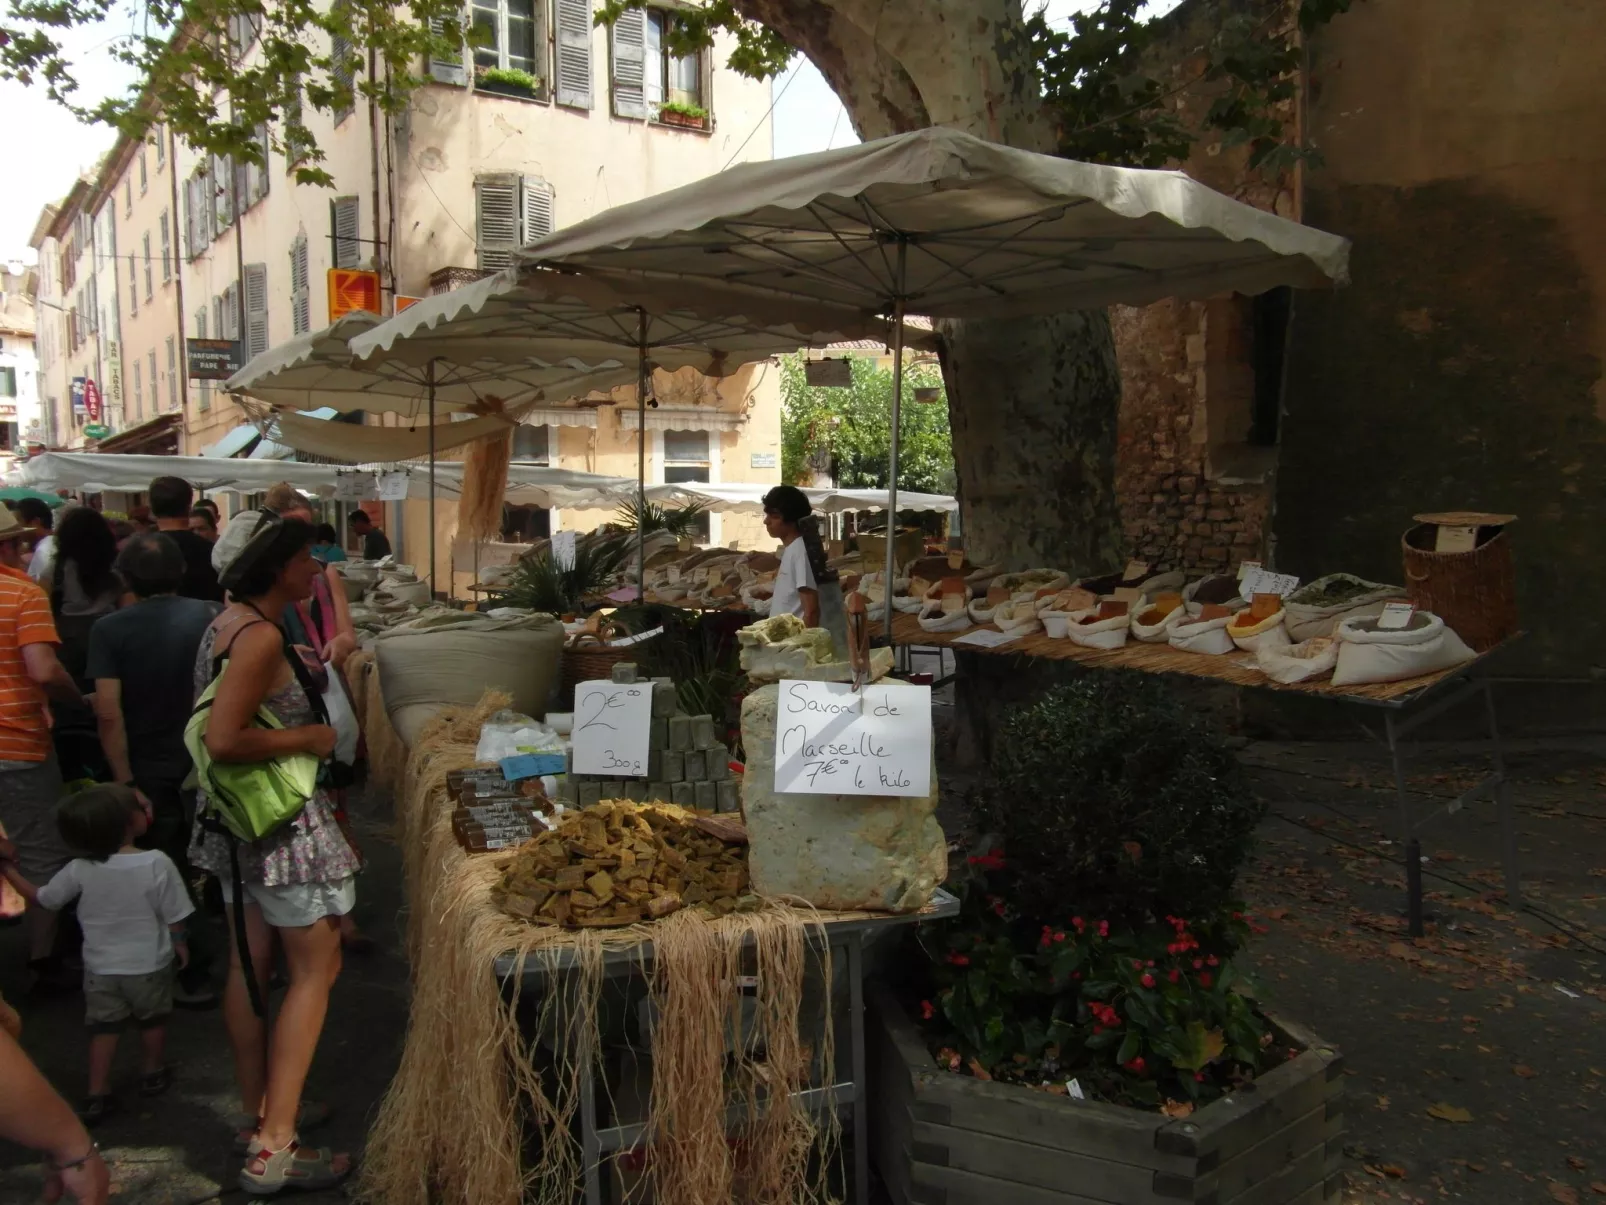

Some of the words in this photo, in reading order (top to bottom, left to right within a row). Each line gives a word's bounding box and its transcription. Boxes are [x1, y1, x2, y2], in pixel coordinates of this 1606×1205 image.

[88, 384, 98, 415] TABAC
[112, 368, 120, 400] TABACS
[787, 683, 855, 713] Savon
[873, 694, 901, 717] de
[782, 724, 892, 758] Marseille
[602, 749, 630, 769] 300
[854, 765, 866, 789] le
